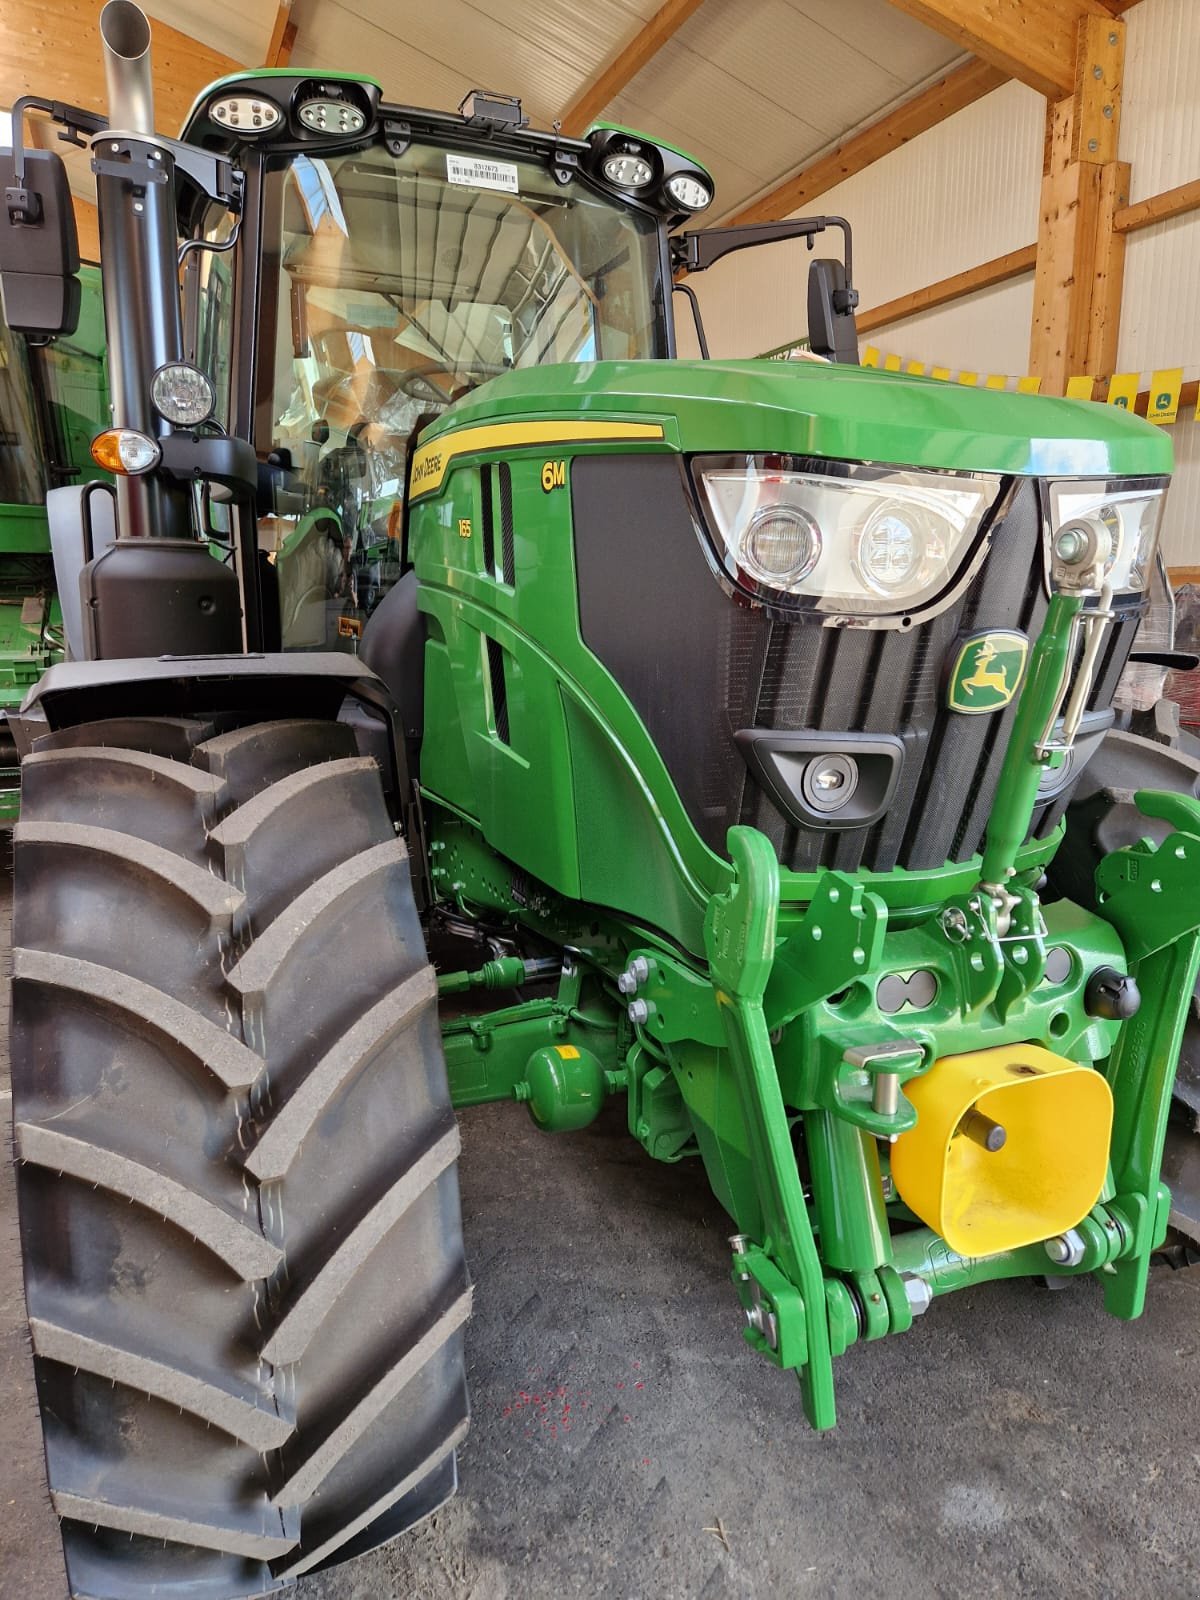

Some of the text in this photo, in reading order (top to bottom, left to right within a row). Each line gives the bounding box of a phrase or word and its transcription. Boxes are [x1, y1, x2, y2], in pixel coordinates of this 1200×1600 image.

[412, 454, 441, 485] JOHN DEERE
[541, 460, 565, 494] 6M
[458, 518, 471, 538] 165
